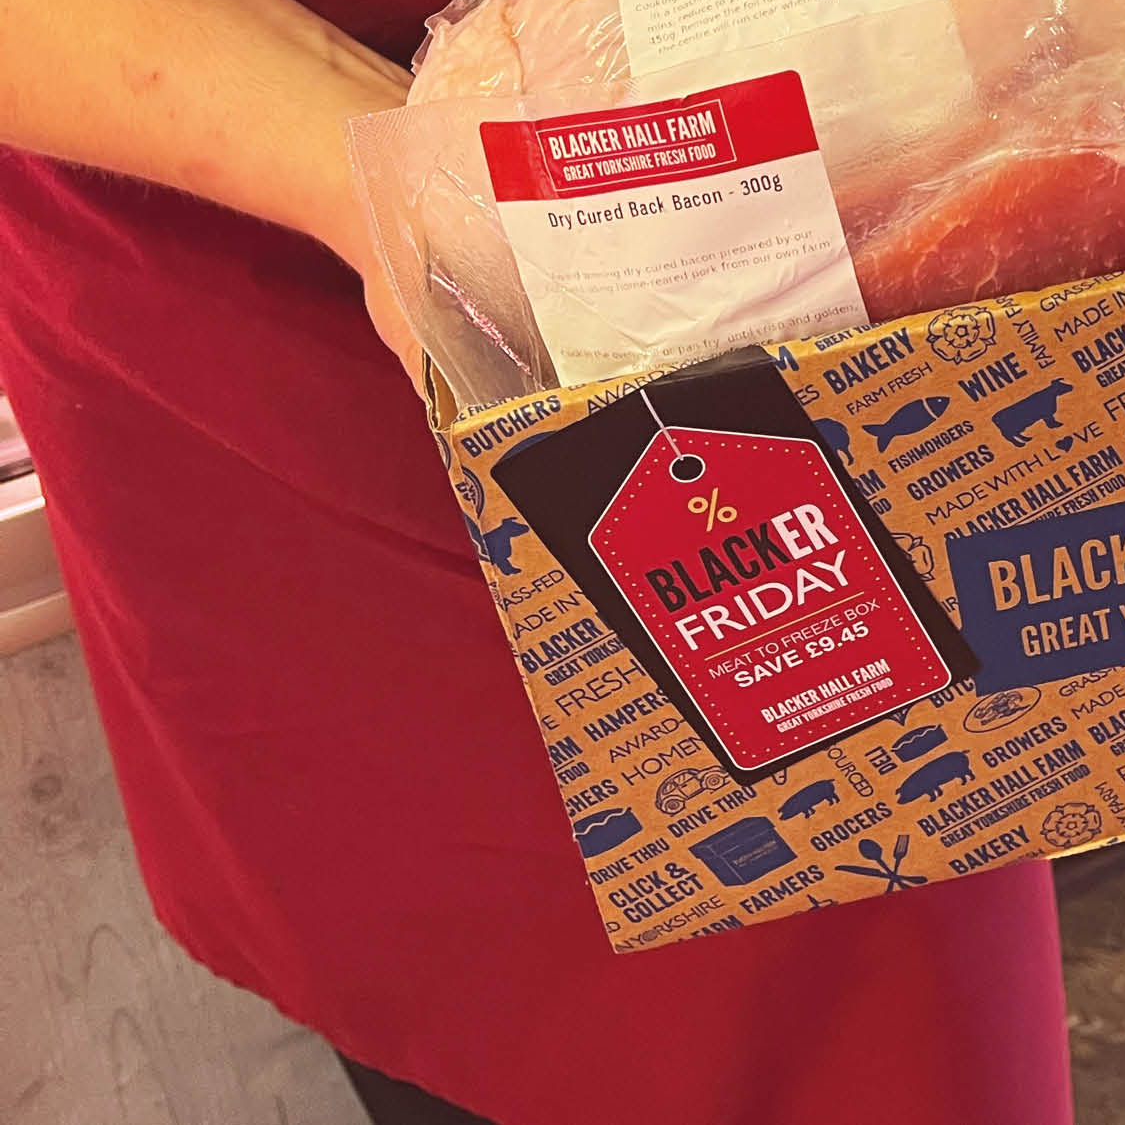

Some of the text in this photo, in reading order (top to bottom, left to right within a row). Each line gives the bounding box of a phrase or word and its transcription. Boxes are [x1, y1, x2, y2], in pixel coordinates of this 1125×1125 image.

[548, 111, 716, 159] BLACKER HALL FARM
[563, 143, 716, 181] GREAT YORKSHIRE FRESH FOOD
[548, 211, 572, 230] Dry
[576, 205, 624, 227] Cured
[630, 196, 665, 217] Back
[672, 189, 723, 211] Bacon
[741, 174, 783, 195] 300g
[682, 230, 813, 268] bacon prepared by our
[693, 240, 831, 280] pork from our own farm
[822, 327, 916, 394] BAKERY
[958, 352, 1027, 403] WINE
[846, 362, 933, 416] FARM FRESH
[460, 395, 562, 457] BUTCHERS
[888, 420, 975, 474] FISHMONGERS
[907, 444, 995, 501] GROWERS
[645, 504, 838, 613] BLACKER
[676, 551, 851, 651] FRIDAY
[708, 598, 881, 680] MEAT TO FREEZE BOX
[733, 620, 870, 688] SAVE £9.45
[1020, 612, 1113, 658] GREAT
[760, 659, 891, 723] BLACKER HALL FARM
[776, 677, 894, 732] GREAT YORKSHIRE FRESH FOOD
[668, 786, 757, 838] DRIVE THRU
[810, 803, 893, 853] GROCERS
[740, 865, 824, 915] FARMERS
